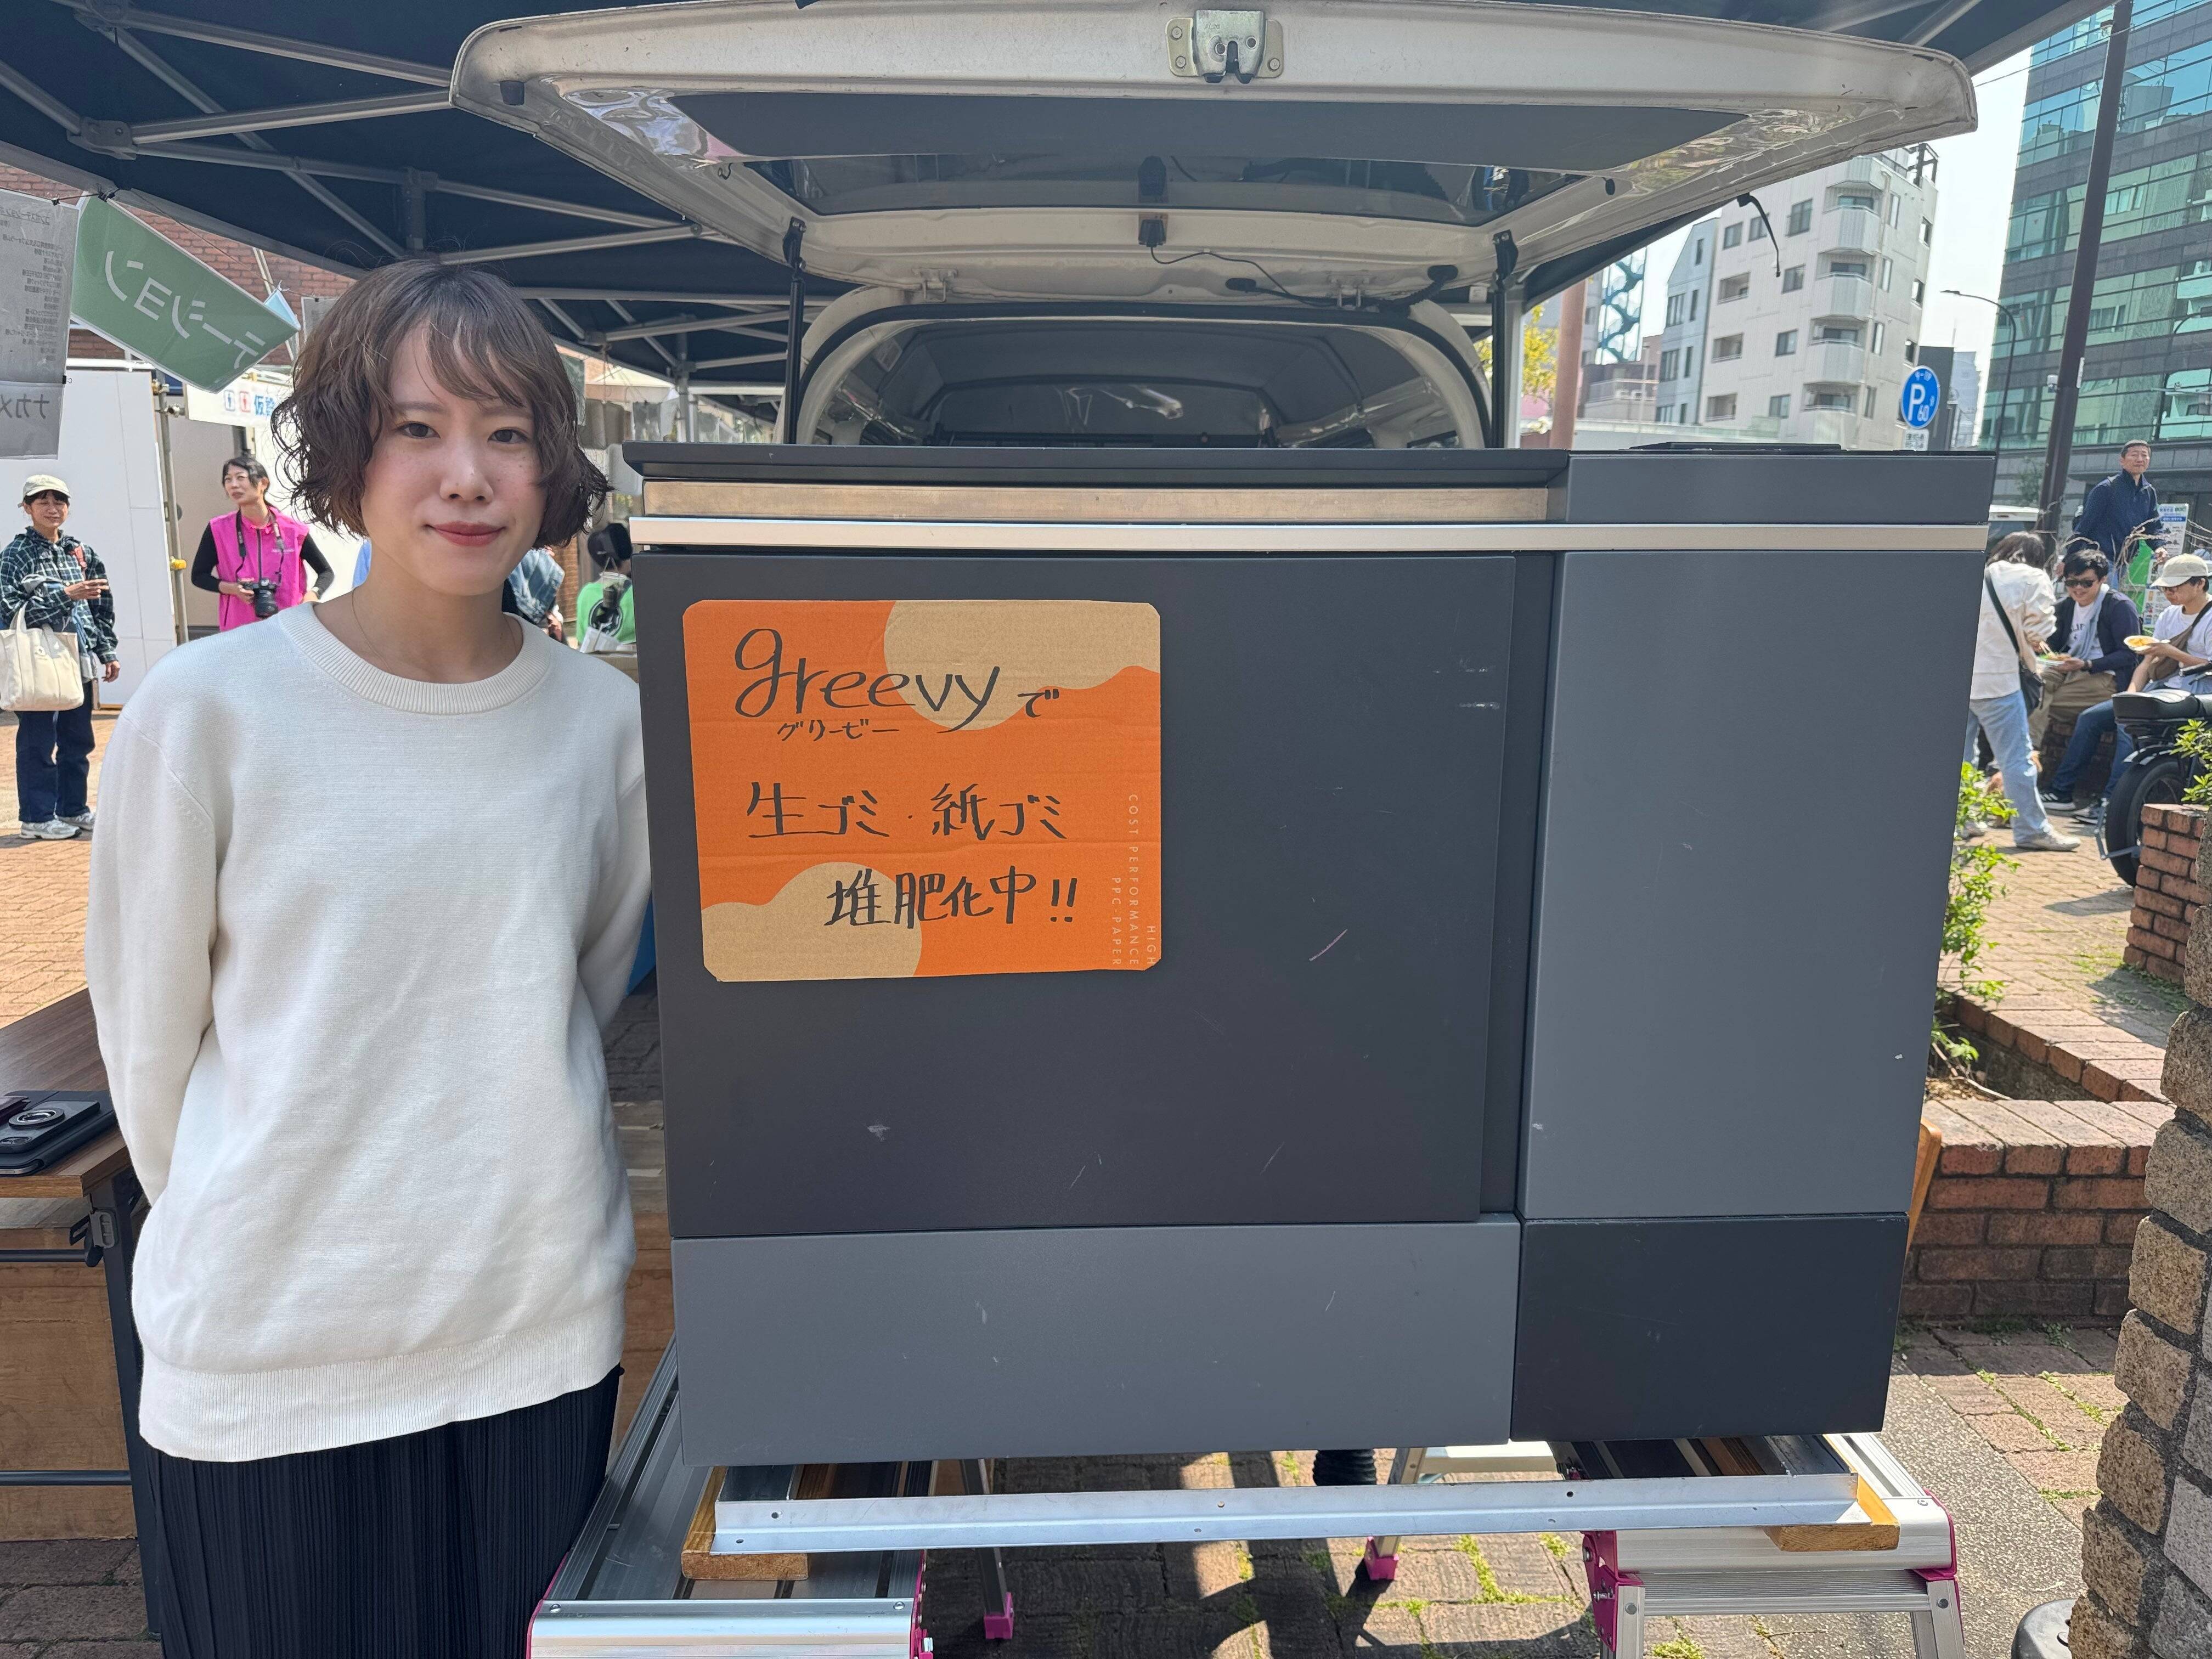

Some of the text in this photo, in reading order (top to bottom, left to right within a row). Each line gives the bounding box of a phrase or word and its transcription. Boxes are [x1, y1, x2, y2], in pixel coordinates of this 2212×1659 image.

[1908, 383, 1926, 421] P
[734, 628, 1060, 733] greevy で
[1111, 877, 1122, 964] PPC-PAPER
[1128, 794, 1139, 965] COST PERFORMANCE
[1147, 925, 1156, 965] HIGH
